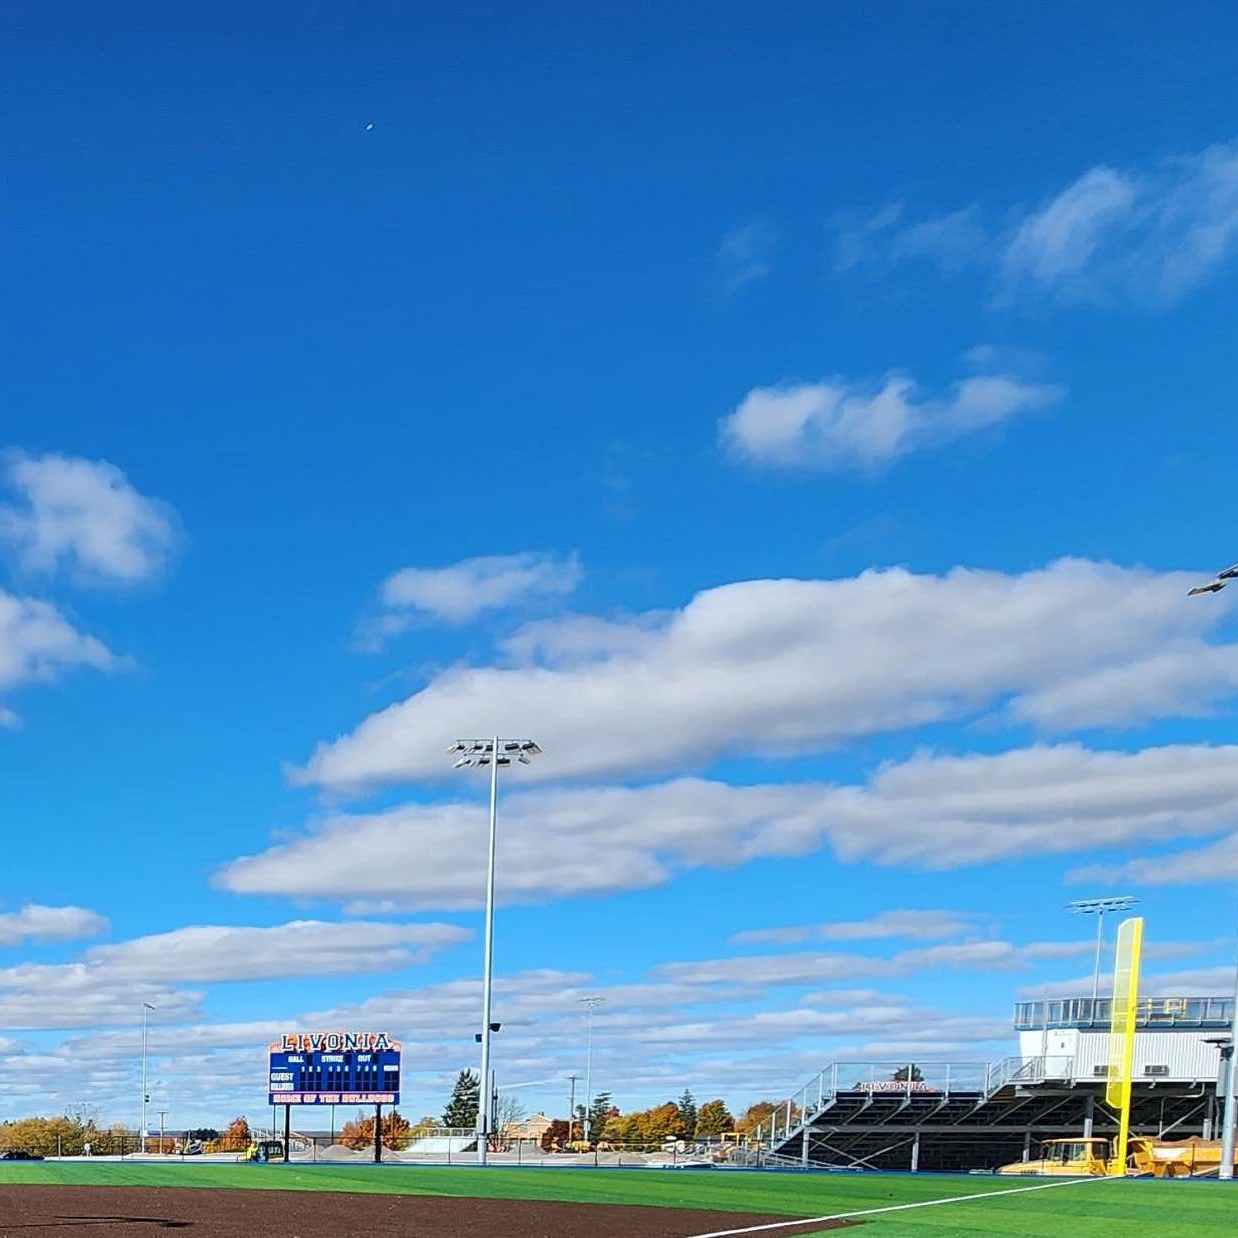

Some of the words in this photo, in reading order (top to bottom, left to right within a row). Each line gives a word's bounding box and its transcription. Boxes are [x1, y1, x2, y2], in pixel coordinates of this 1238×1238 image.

[281, 1032, 390, 1050] LIVONIA
[270, 1072, 295, 1081] GUEST
[303, 1094, 317, 1103] OF
[319, 1094, 340, 1103] THE
